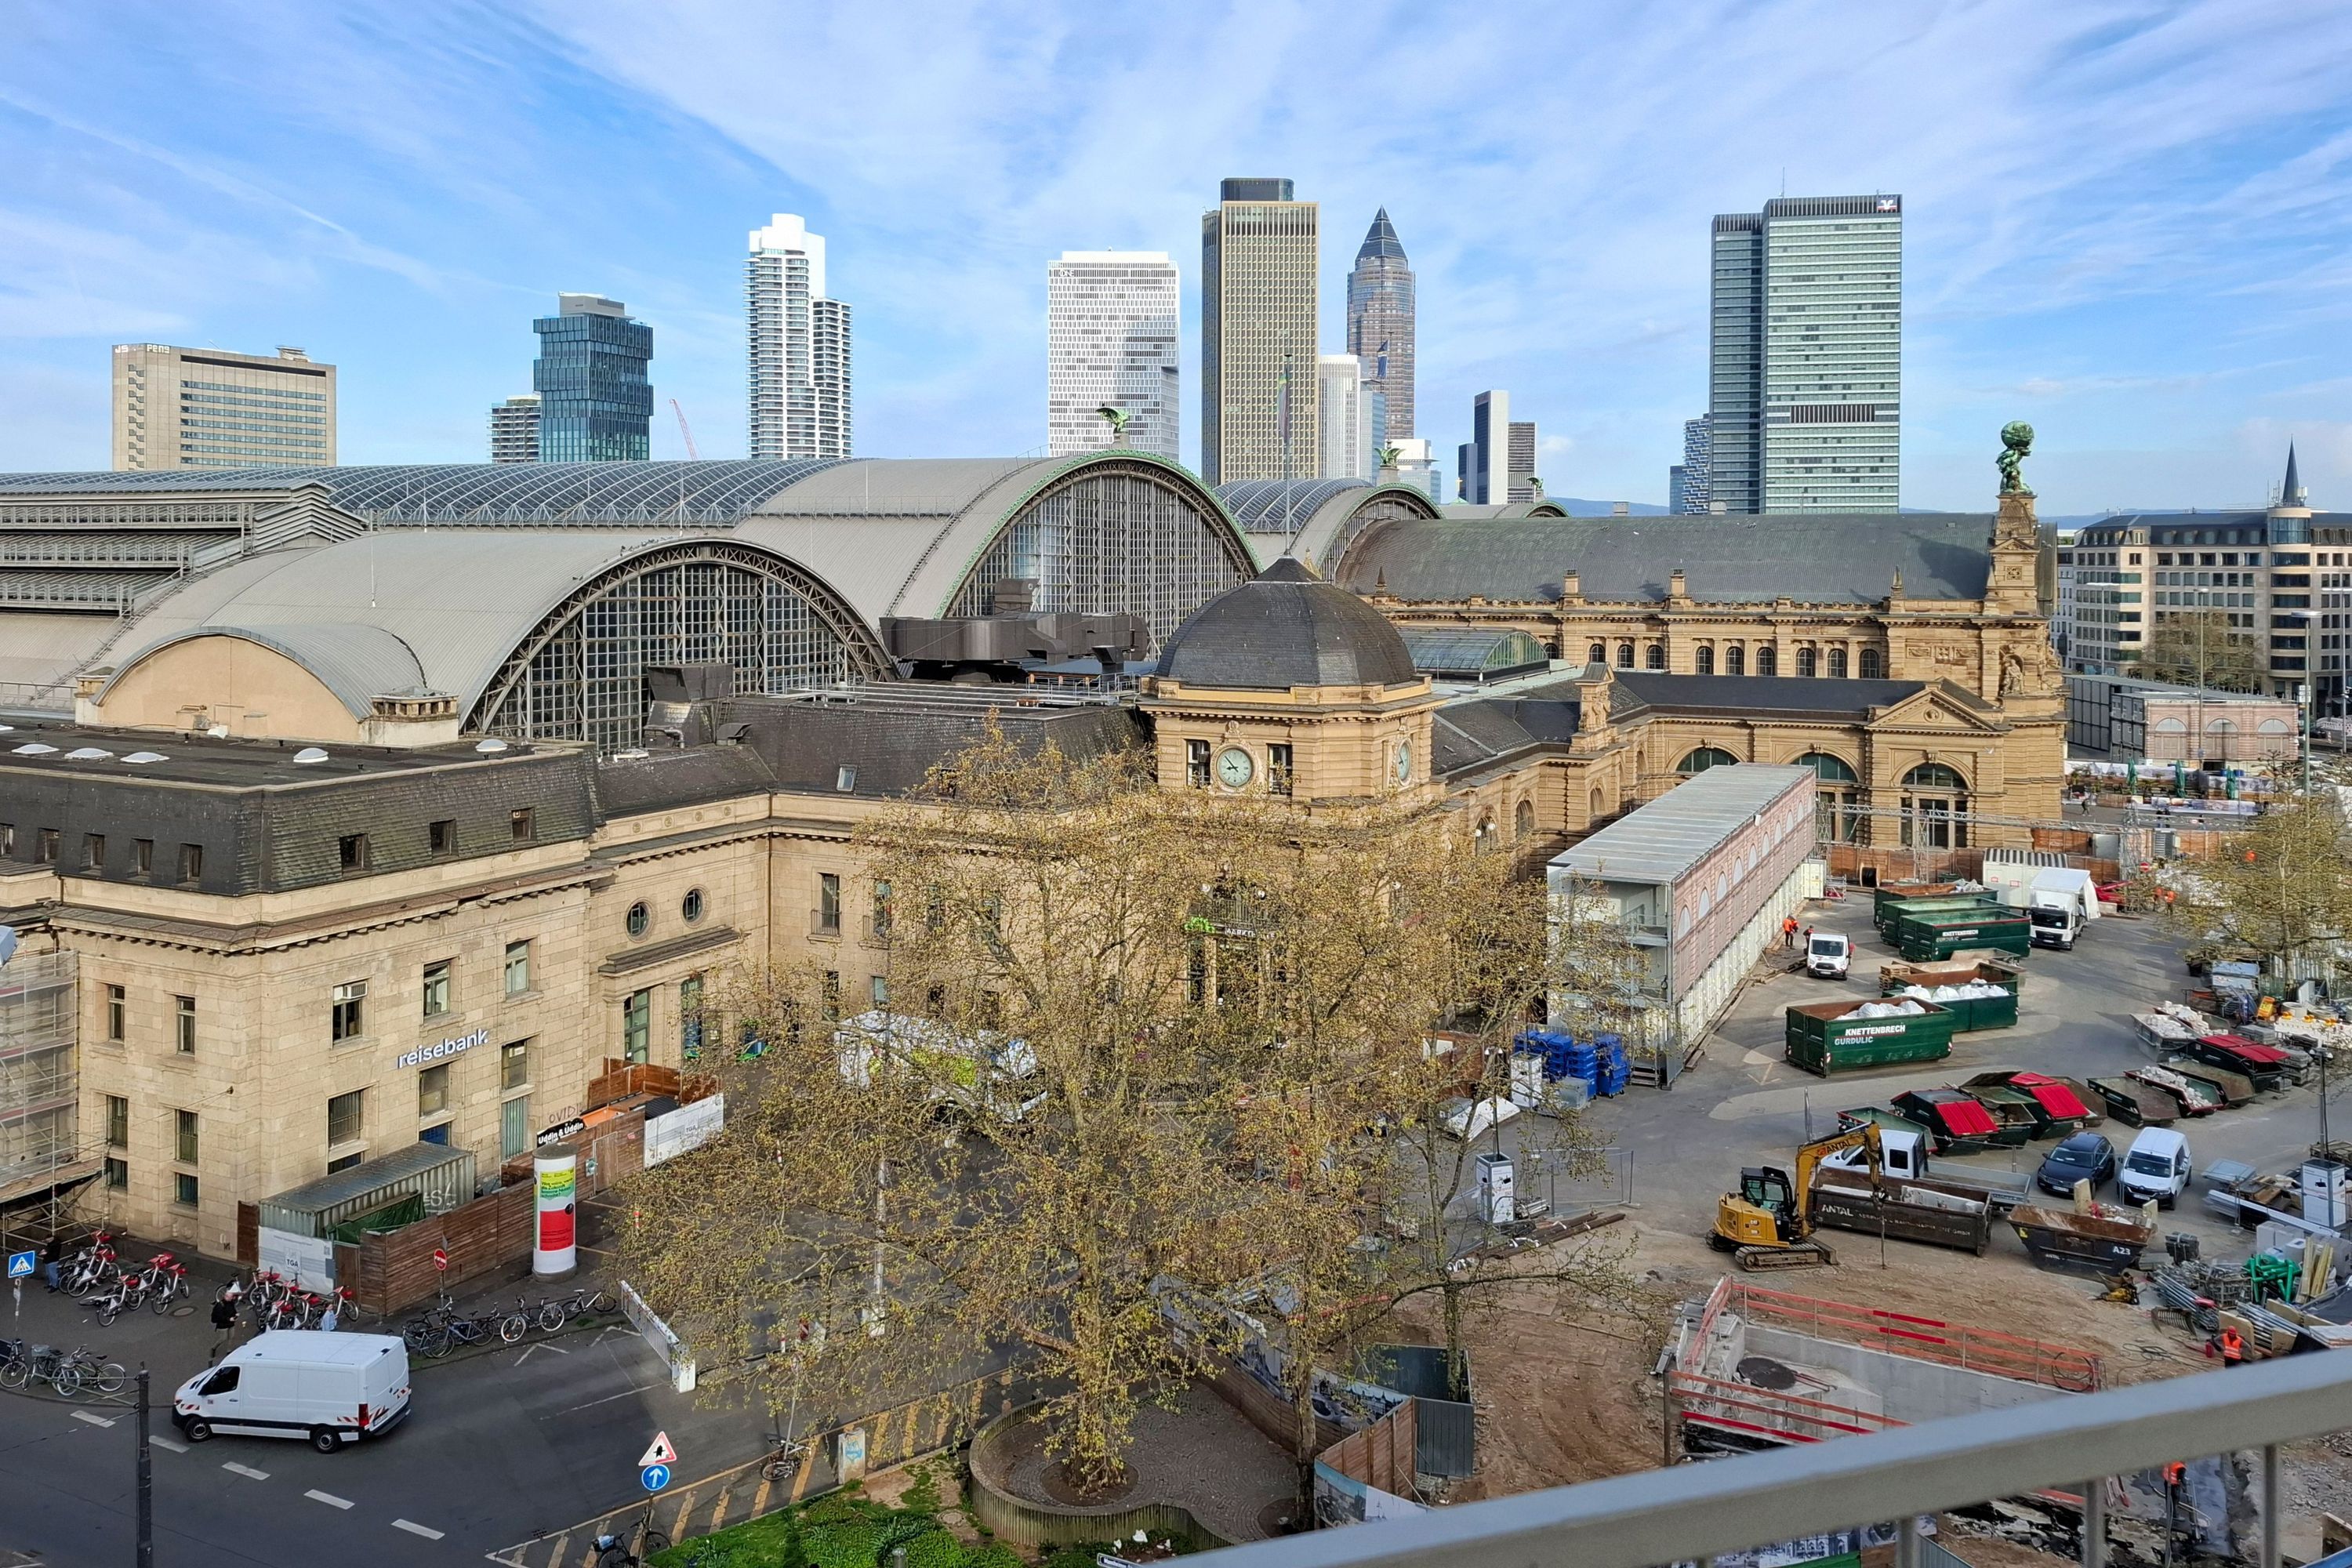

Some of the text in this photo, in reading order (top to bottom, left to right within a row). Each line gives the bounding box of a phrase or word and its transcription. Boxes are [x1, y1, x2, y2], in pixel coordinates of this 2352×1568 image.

[1845, 1025, 1906, 1036] KNETTENBRECH
[1835, 1036, 1874, 1046] GURDULIC
[1827, 1139, 1851, 1154] ANTAL
[1821, 1204, 1853, 1217] ANTAL
[2113, 1246, 2130, 1255] A23
[286, 1258, 299, 1268] TGA
